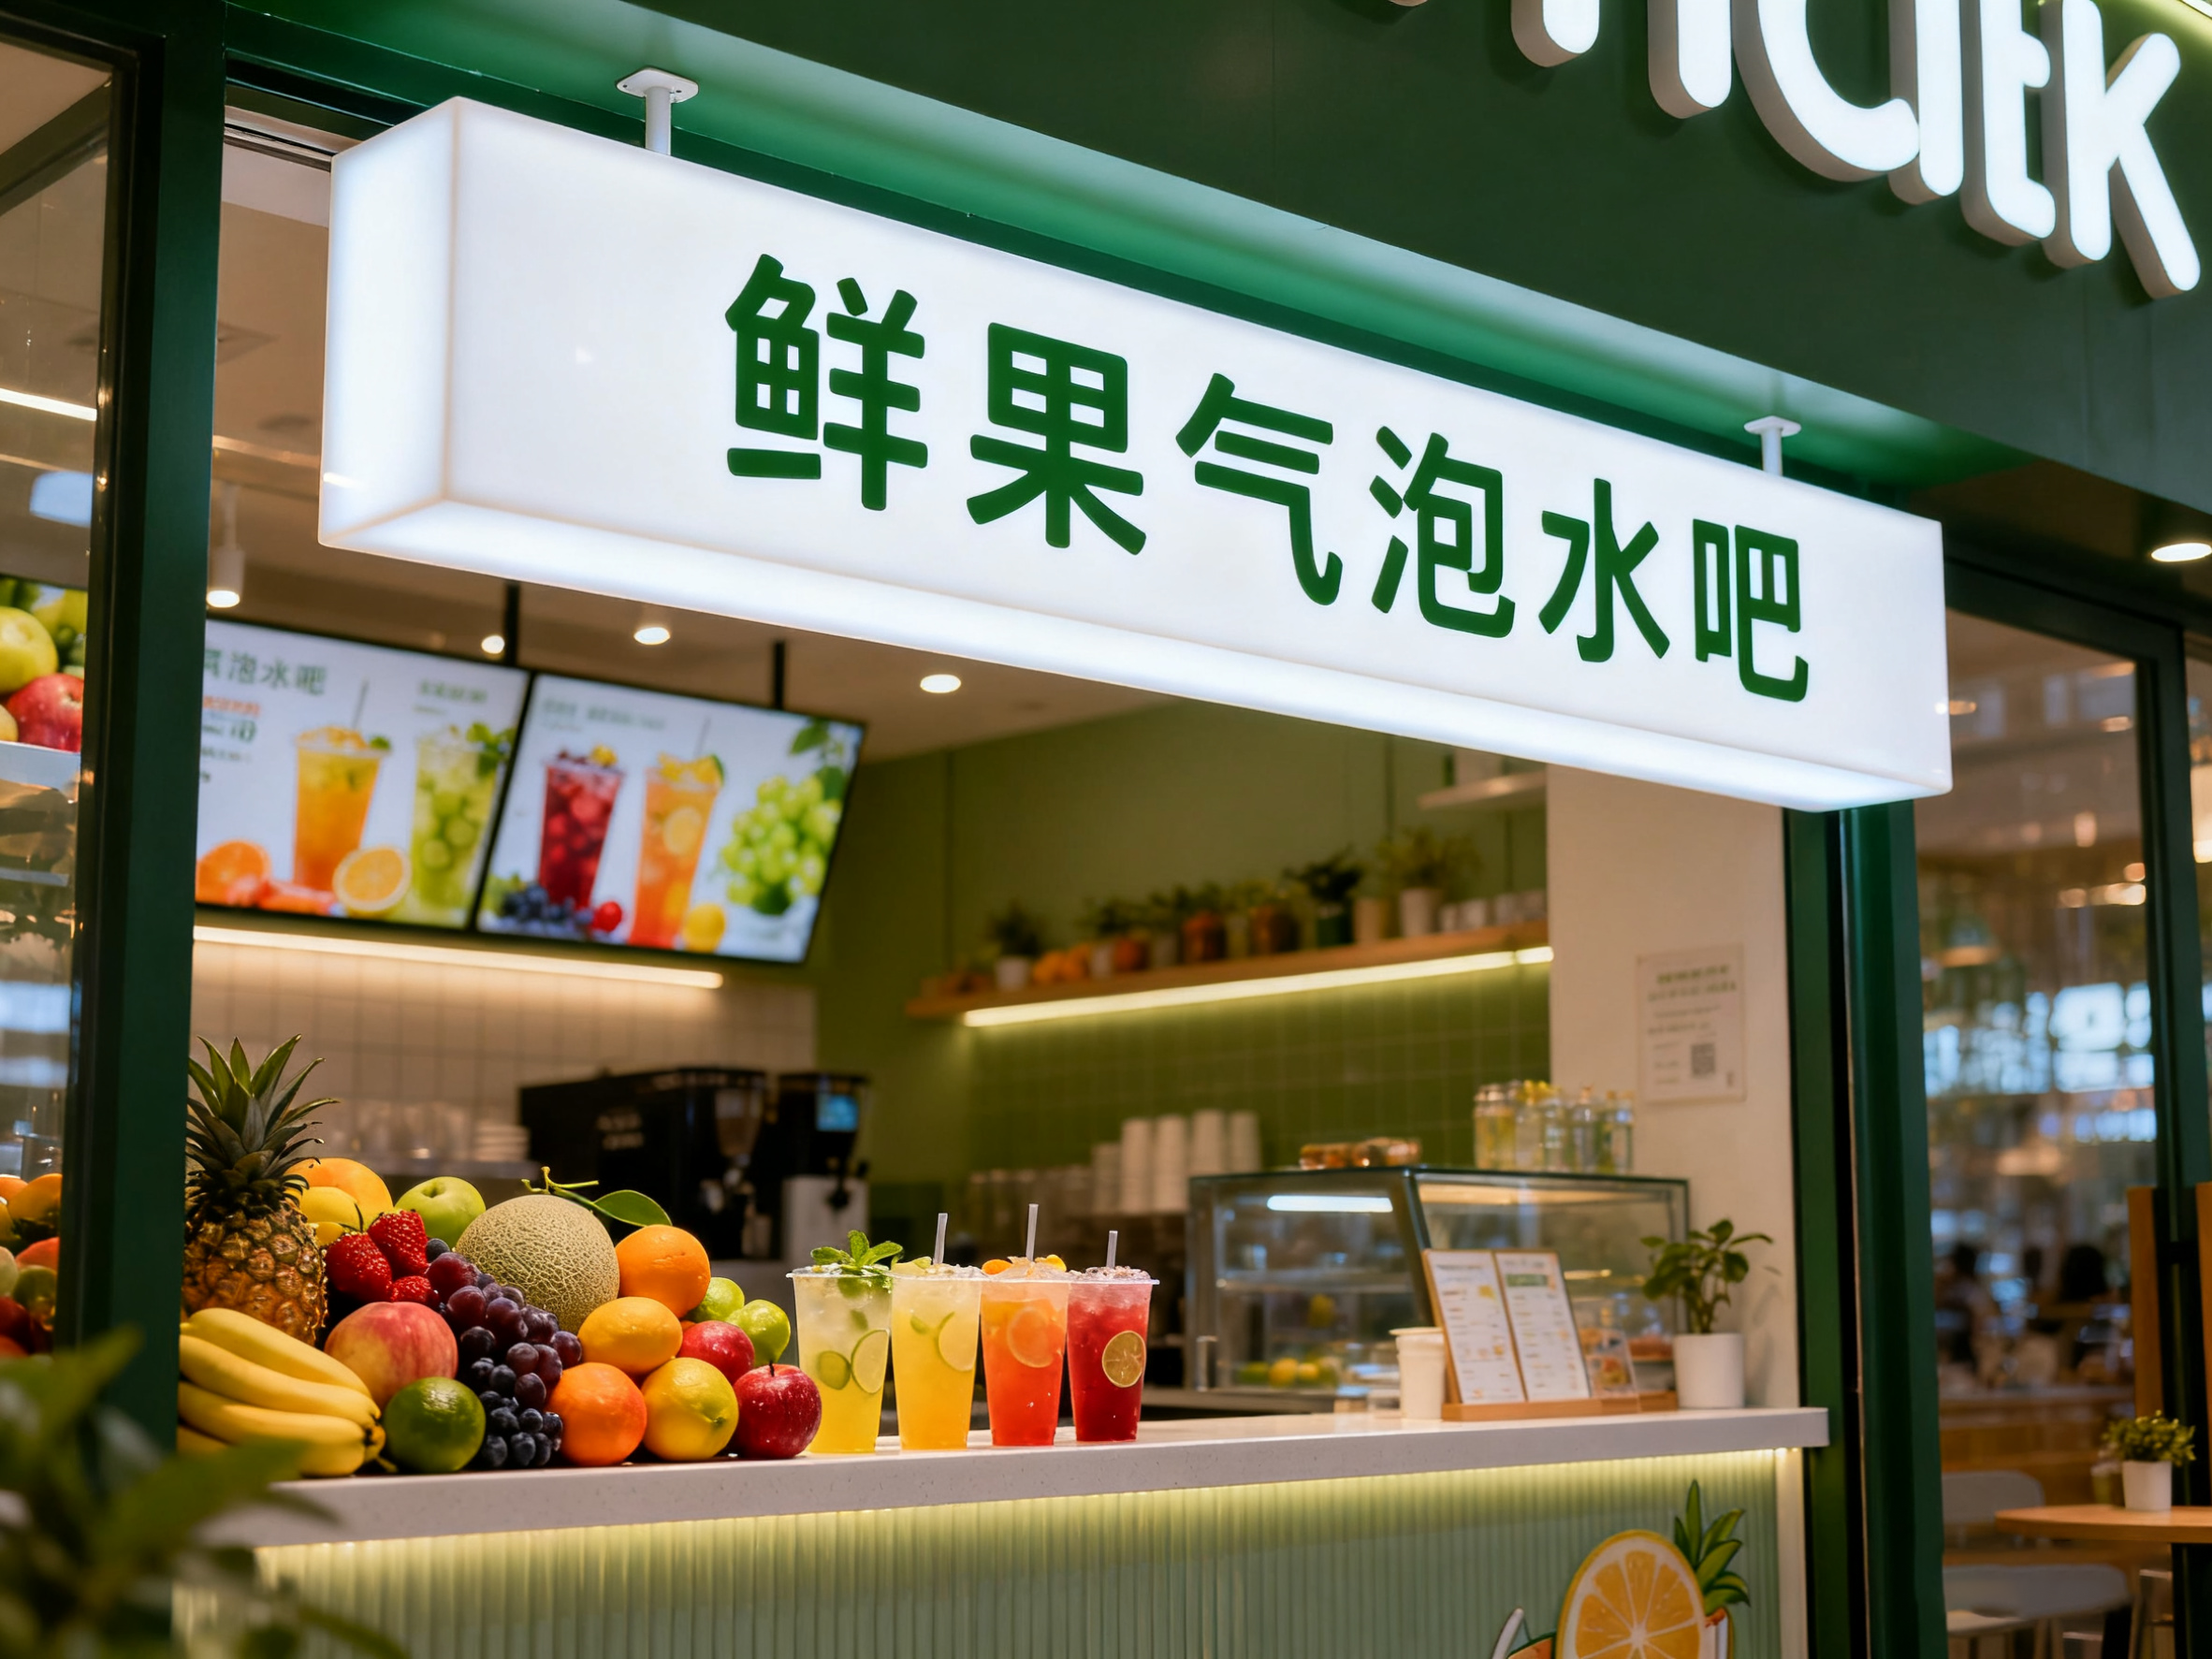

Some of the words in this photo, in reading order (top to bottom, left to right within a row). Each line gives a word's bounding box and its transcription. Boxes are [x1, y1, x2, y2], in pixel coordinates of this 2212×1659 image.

[724, 254, 1809, 703] 鲜果气泡水吧
